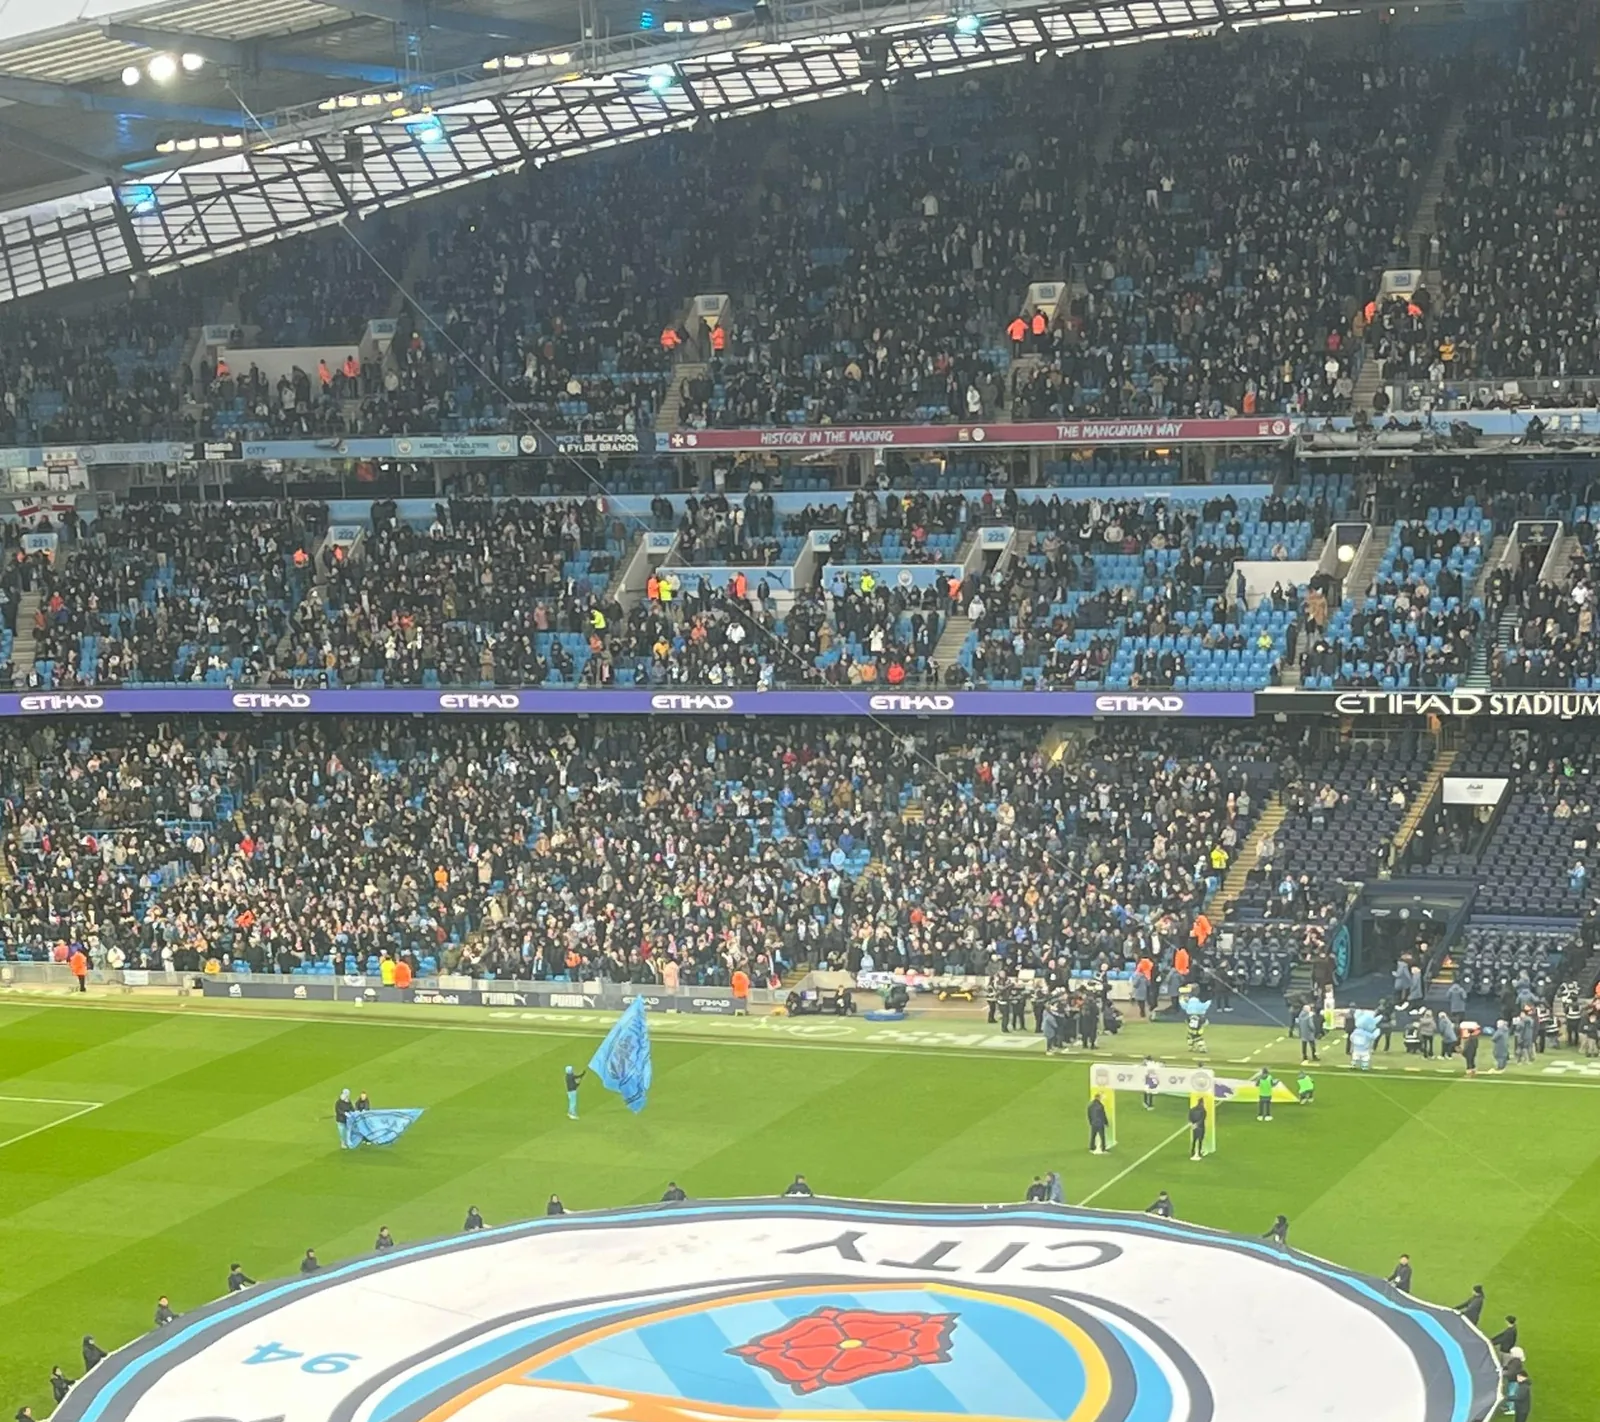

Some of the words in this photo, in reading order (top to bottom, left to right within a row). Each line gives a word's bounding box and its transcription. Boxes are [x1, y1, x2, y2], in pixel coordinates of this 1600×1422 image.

[583, 434, 639, 442] BLACKPOOL
[761, 432, 807, 444] HISTORY
[809, 432, 822, 443] IN
[824, 431, 846, 443] THE
[849, 430, 895, 442] MAKING
[1056, 425, 1079, 438] THE
[1082, 424, 1153, 438] MANCUNIAN
[1156, 423, 1183, 436] WAY
[246, 447, 266, 455] CITY
[558, 444, 565, 452] &
[567, 444, 597, 452] FYLDE
[599, 443, 638, 452] BRANCH
[20, 693, 104, 710] ETIHAD
[232, 693, 311, 708] ETIHAD
[439, 694, 520, 709] ETIHAD
[651, 694, 734, 709] ETIHAD
[869, 695, 954, 710] ETIHAD
[1095, 695, 1184, 711] ETIHAD
[1335, 693, 1482, 714] ETIHAD
[1489, 693, 1600, 715] STADIUM
[481, 993, 515, 1006] PUMA
[550, 994, 583, 1008] PUMA
[692, 998, 731, 1008] ETIHAD
[777, 1230, 1124, 1275] CITY
[242, 1341, 363, 1375] 94
